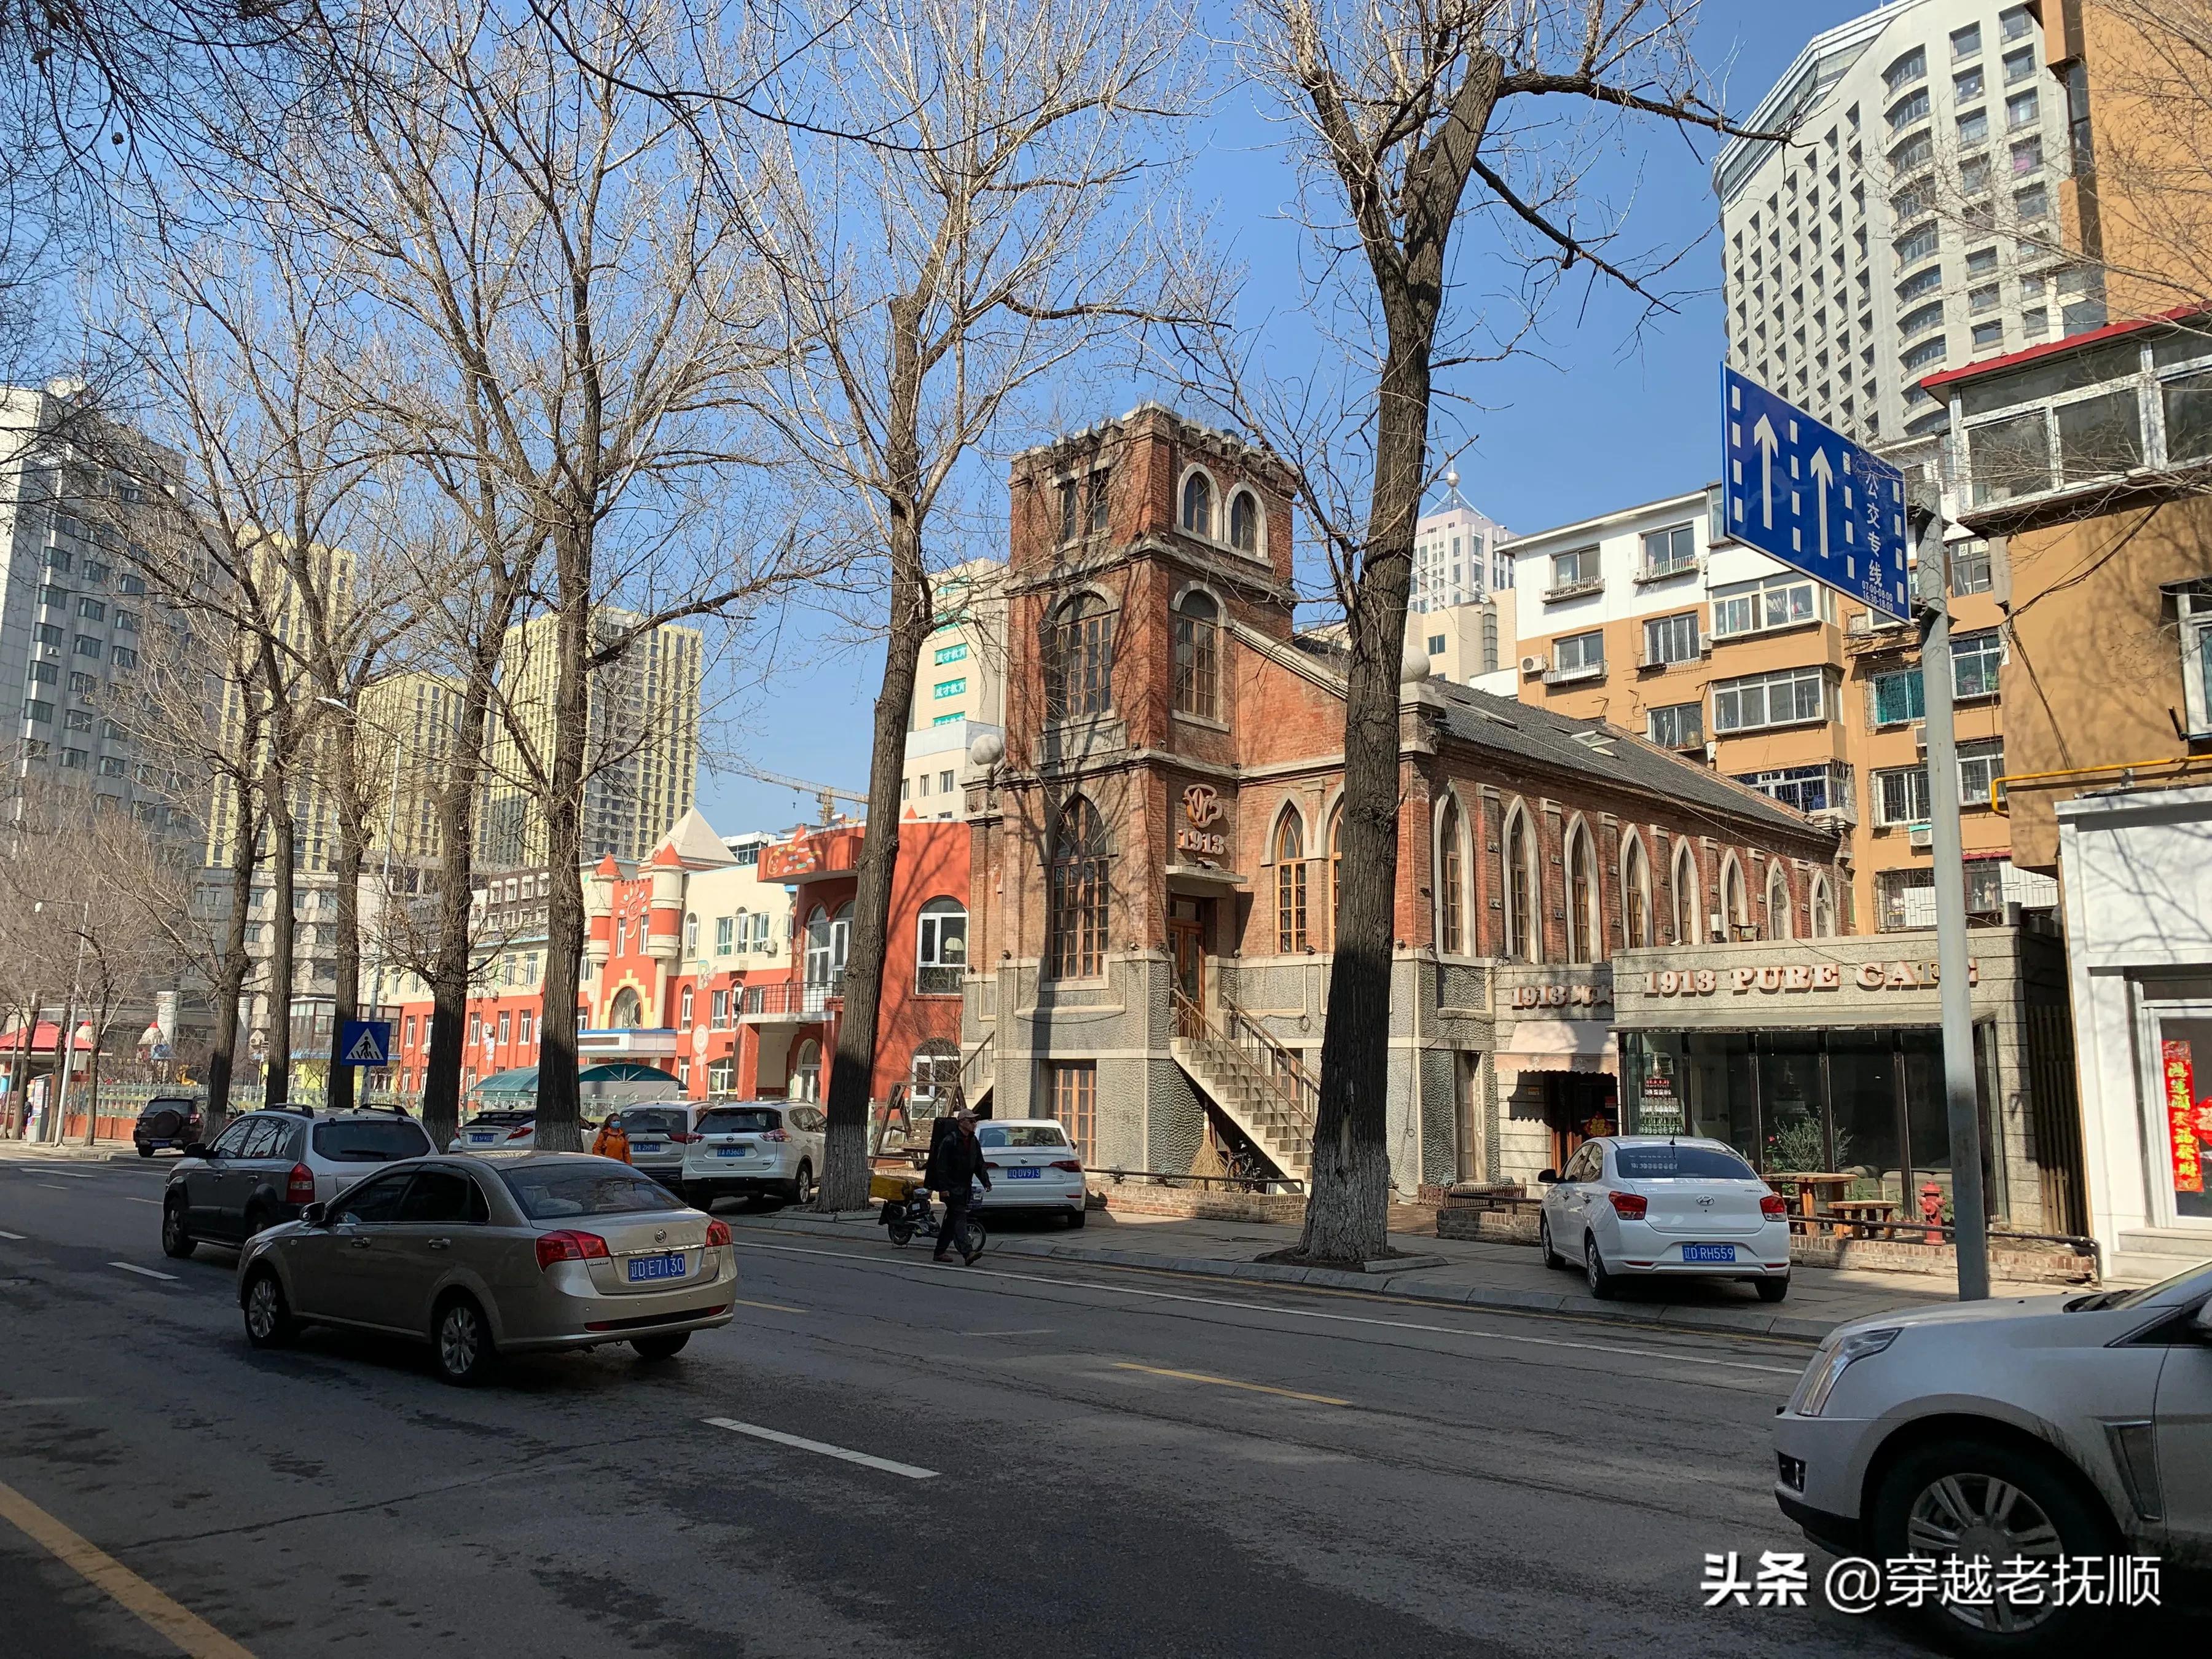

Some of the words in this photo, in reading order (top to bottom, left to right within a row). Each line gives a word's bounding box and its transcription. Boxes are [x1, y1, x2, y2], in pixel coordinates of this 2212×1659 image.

[1865, 473, 1883, 587] 公交专线
[1862, 580, 1893, 602] 07:00-08:00
[1862, 590, 1894, 612] 16:30-18:00
[936, 647, 966, 664] 成才教育
[935, 681, 965, 697] 成才教育
[1178, 828, 1224, 855] 1913
[1644, 970, 1716, 993] 1913
[1731, 963, 1840, 990] PURE
